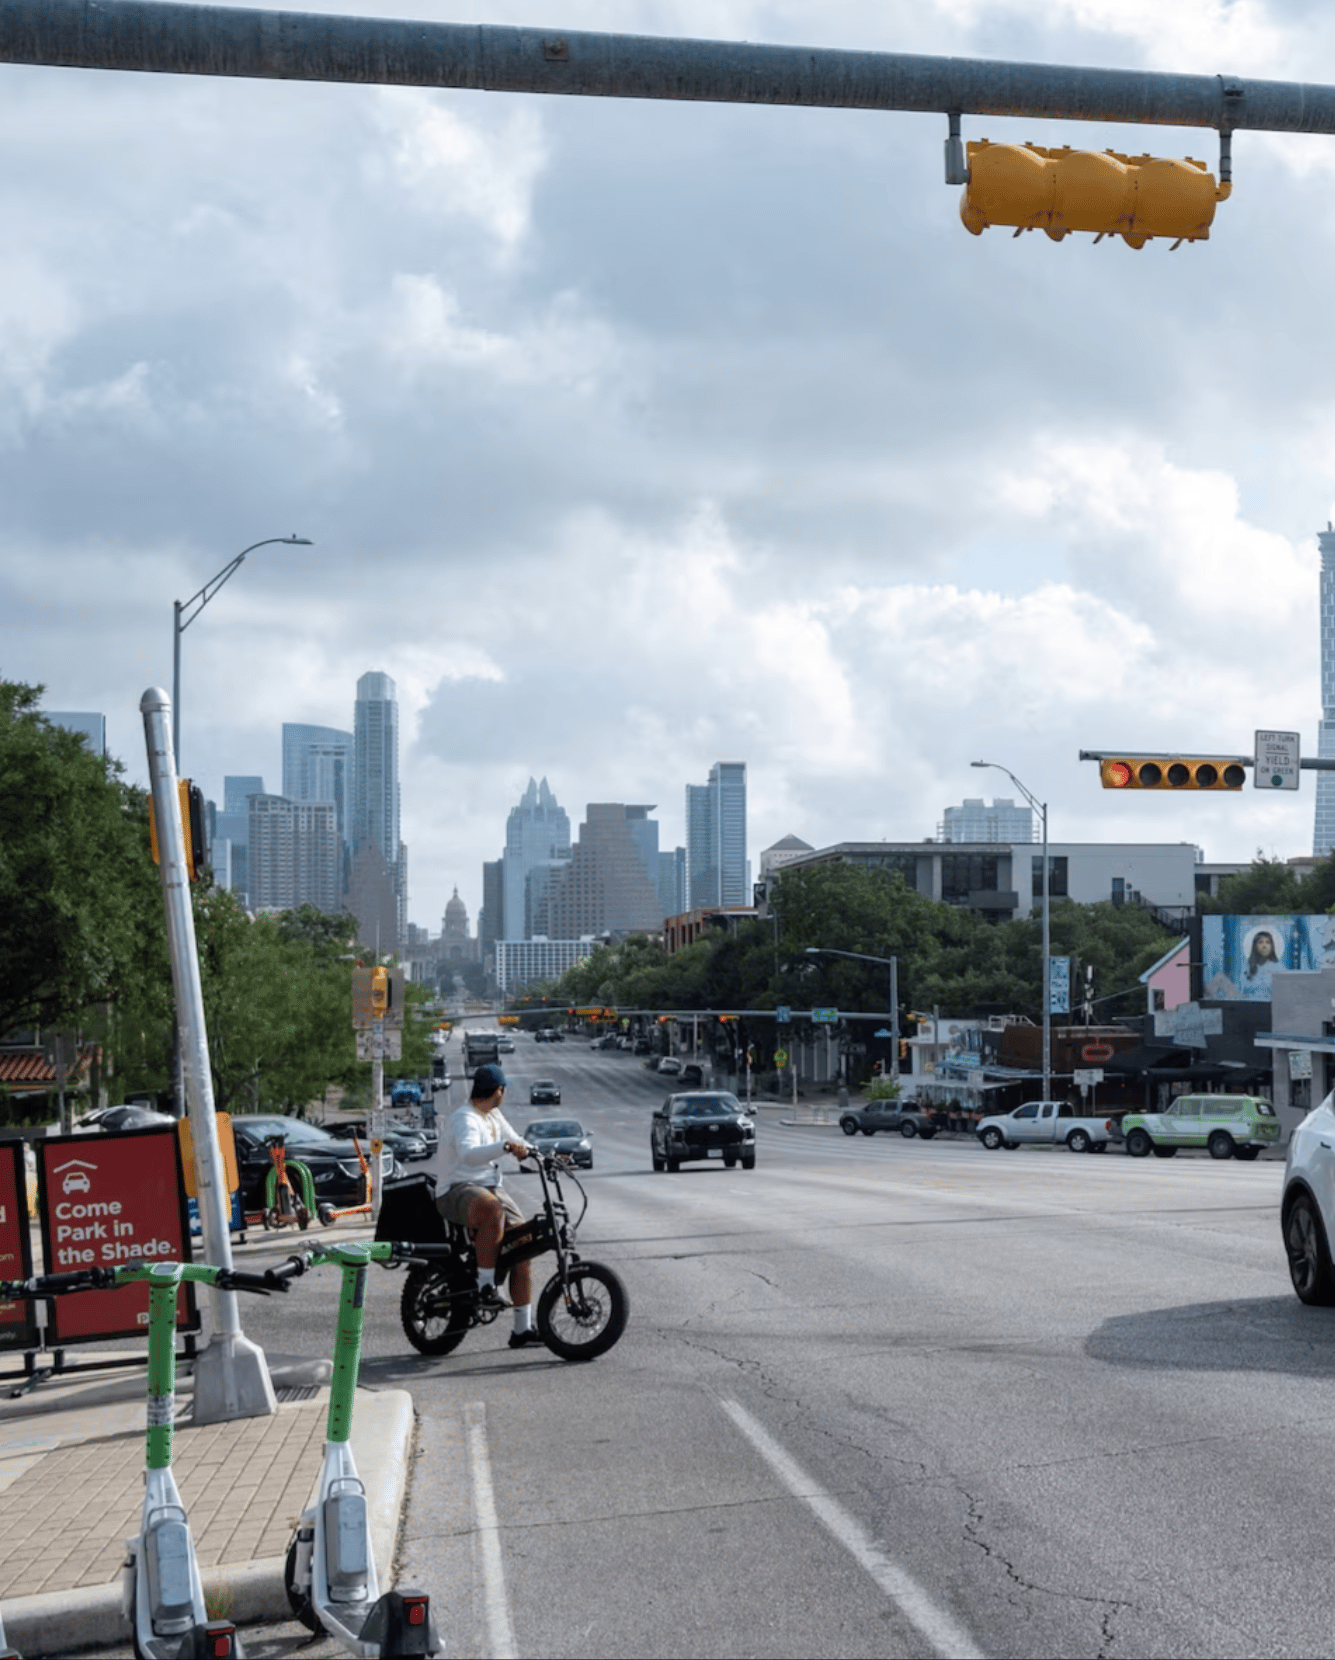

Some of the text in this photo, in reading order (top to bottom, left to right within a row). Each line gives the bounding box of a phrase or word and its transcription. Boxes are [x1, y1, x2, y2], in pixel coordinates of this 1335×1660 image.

[1266, 743, 1288, 751] SIGNAL
[1265, 755, 1290, 765] YIELD
[1260, 766, 1294, 775] ON GREEN
[56, 1201, 122, 1220] Come
[57, 1219, 134, 1243] Park in
[58, 1238, 177, 1265] the Shade.
